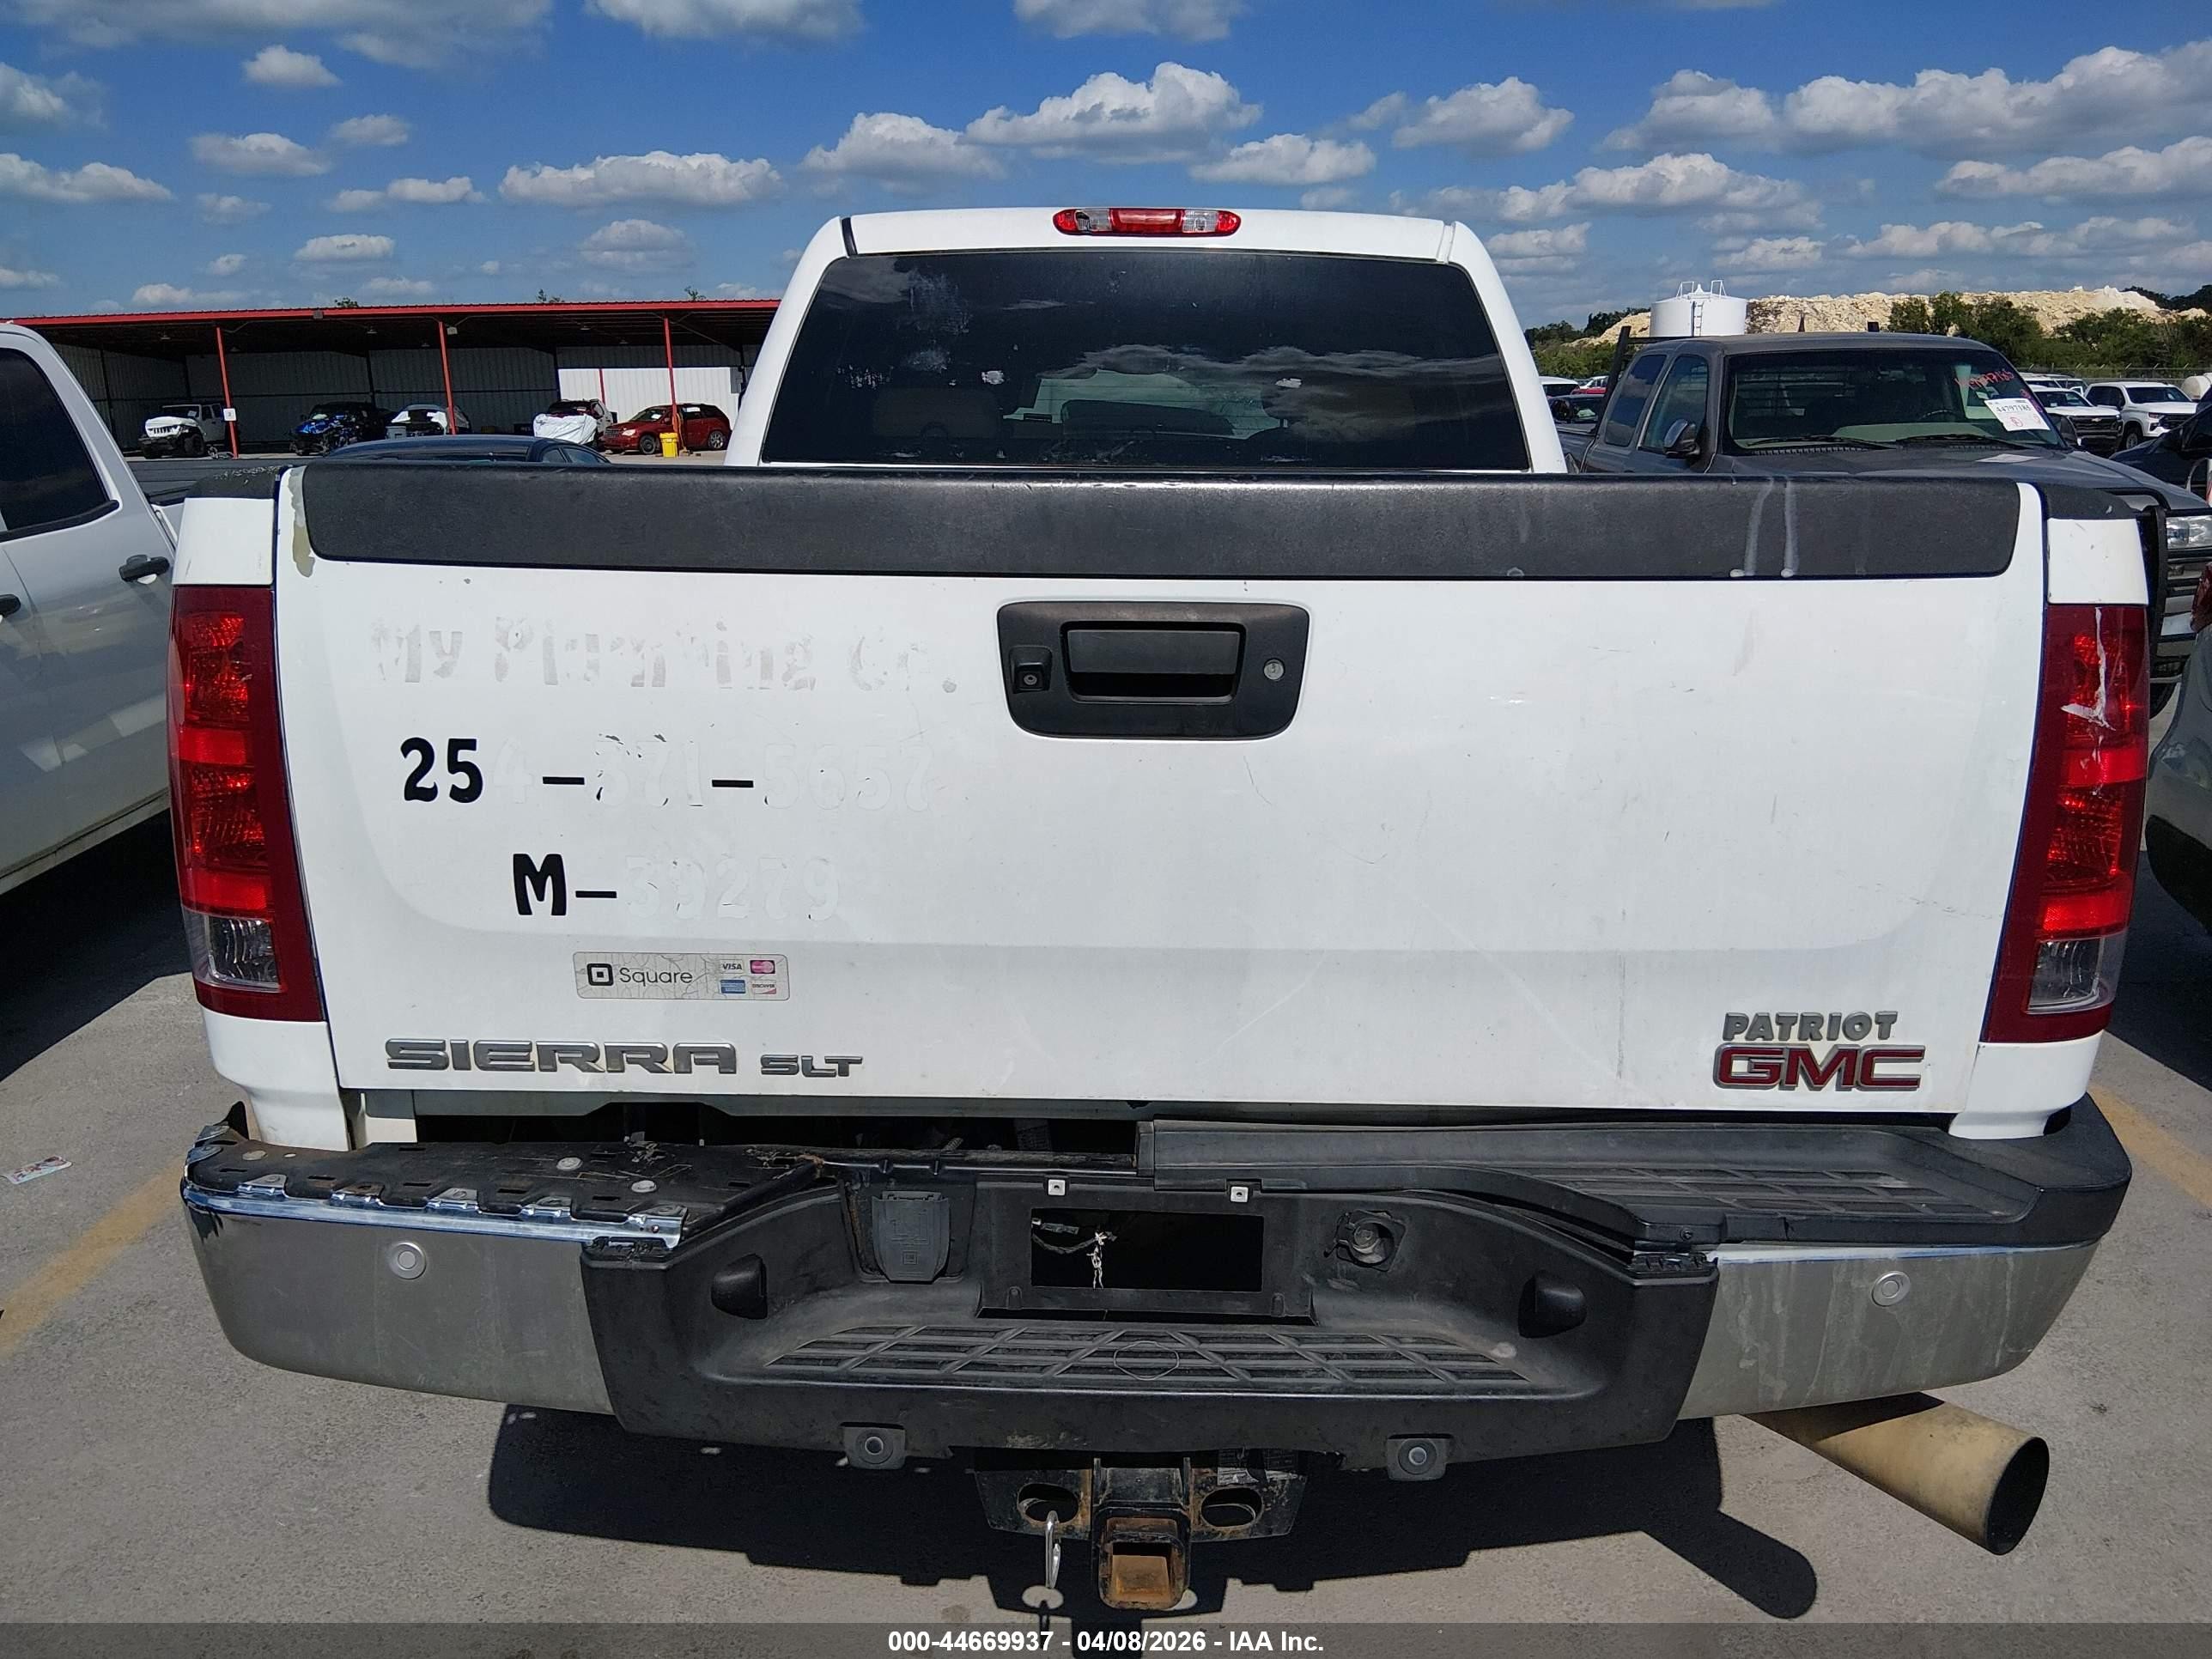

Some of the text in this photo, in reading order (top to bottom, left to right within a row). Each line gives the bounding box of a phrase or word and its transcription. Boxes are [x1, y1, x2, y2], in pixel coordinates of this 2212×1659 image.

[619, 967, 693, 987] Square
[1723, 1011, 1898, 1041] PATRIOT
[385, 1038, 863, 1078] SIERRA SLT
[1713, 1042, 1925, 1091] GMC
